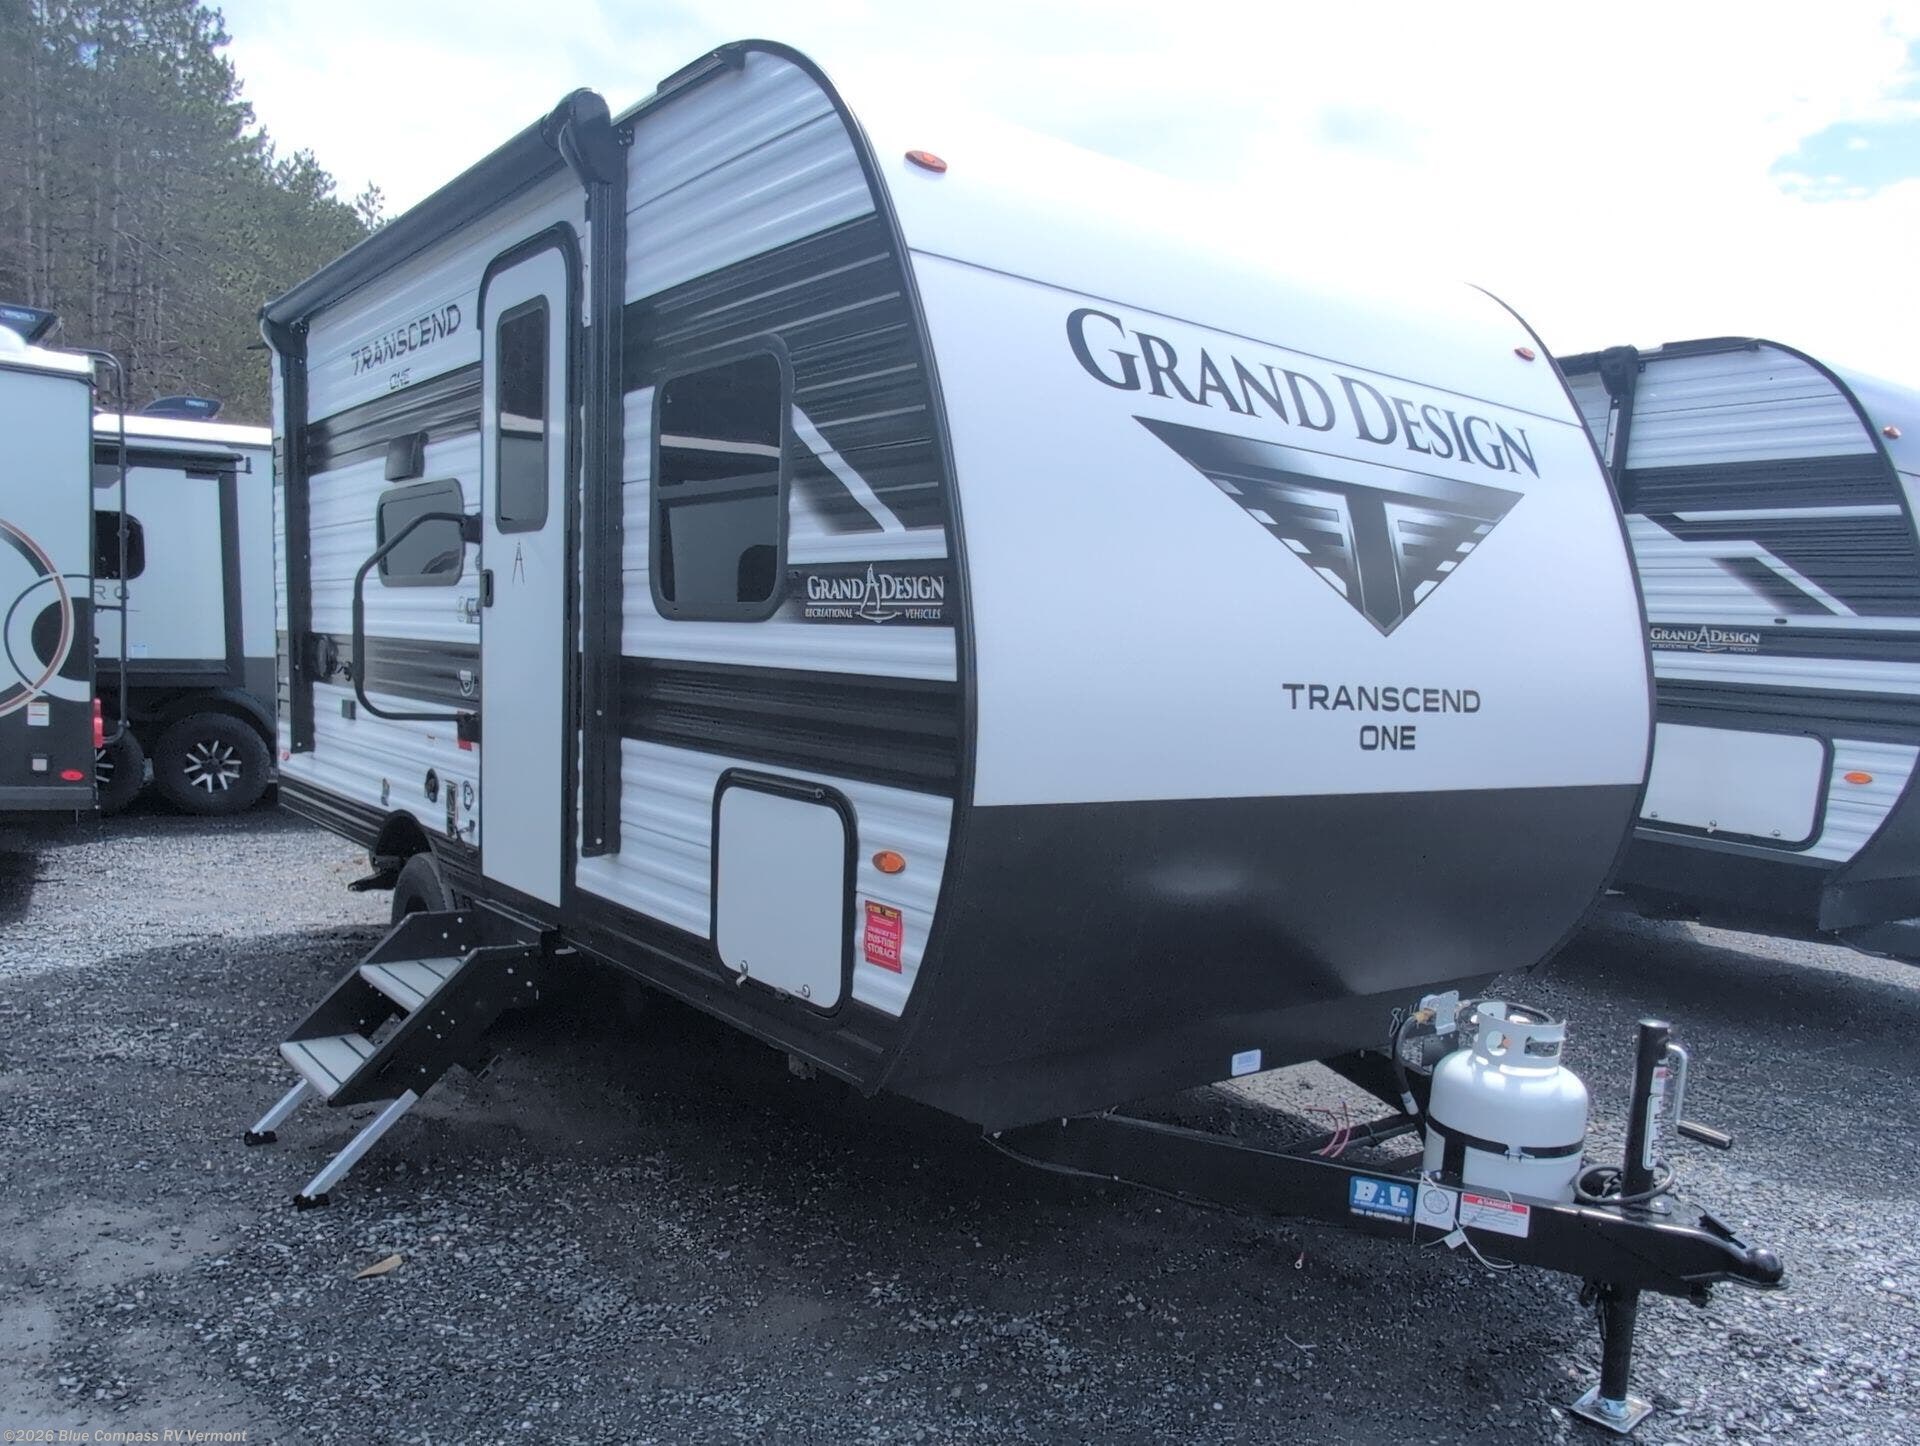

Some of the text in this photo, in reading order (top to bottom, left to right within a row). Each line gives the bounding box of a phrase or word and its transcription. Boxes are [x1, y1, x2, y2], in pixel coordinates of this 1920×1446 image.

[350, 303, 462, 377] TRANSCEND
[1066, 307, 1541, 480] GRAND DESIGN
[806, 573, 945, 600] GRAND DESIGN
[804, 607, 942, 620] RECREATIONAL VEHICLES
[1649, 627, 1761, 645] GRAND DESIGN
[1282, 683, 1481, 714] TRANSCEND
[1358, 725, 1417, 751] ONE
